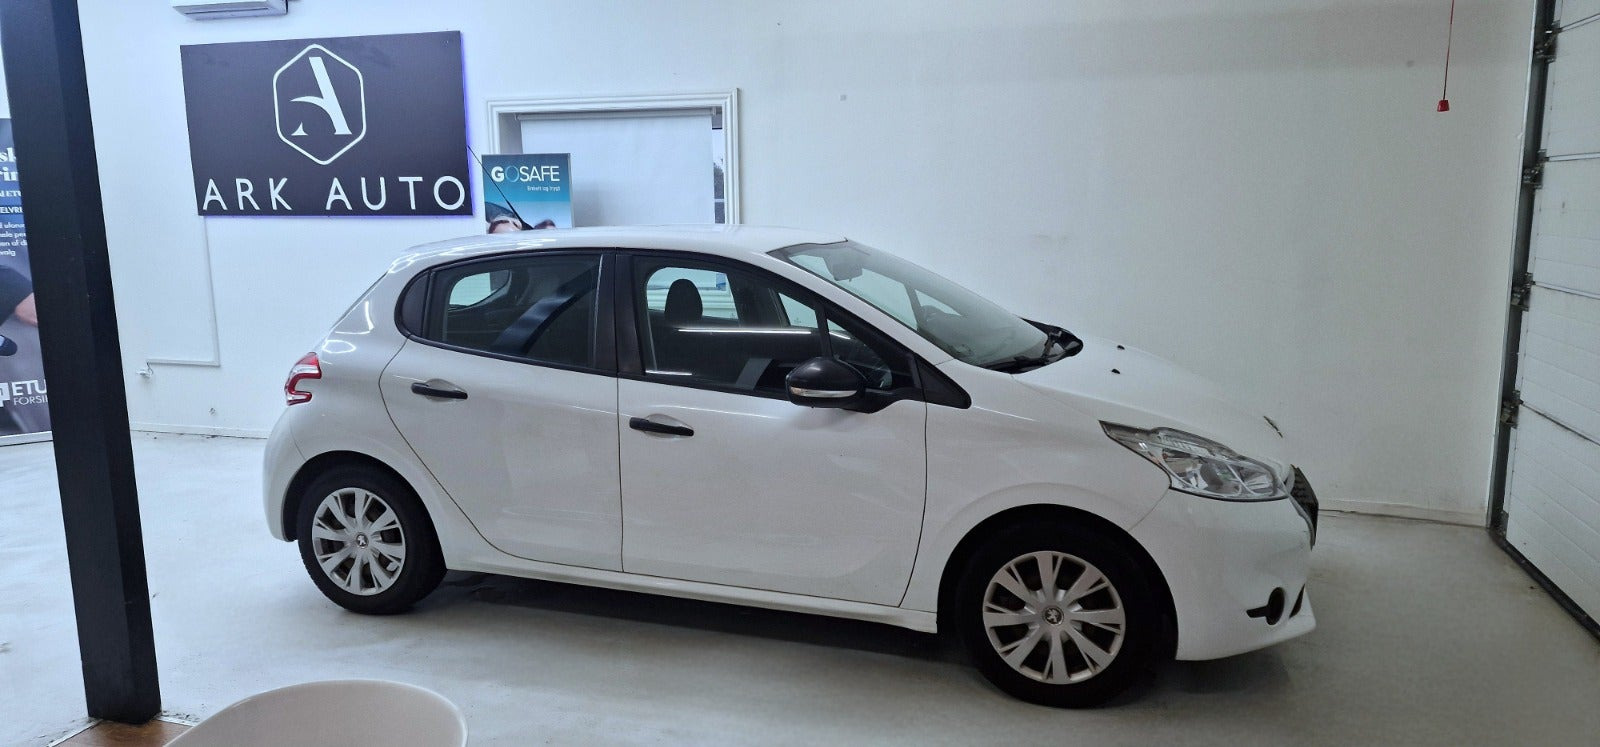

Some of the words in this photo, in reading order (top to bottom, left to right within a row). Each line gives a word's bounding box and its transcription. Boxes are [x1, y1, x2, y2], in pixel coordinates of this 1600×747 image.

[491, 165, 560, 182] GOSAFE
[203, 177, 292, 211] ARK
[325, 175, 465, 211] AUTO
[12, 379, 47, 395] ETU
